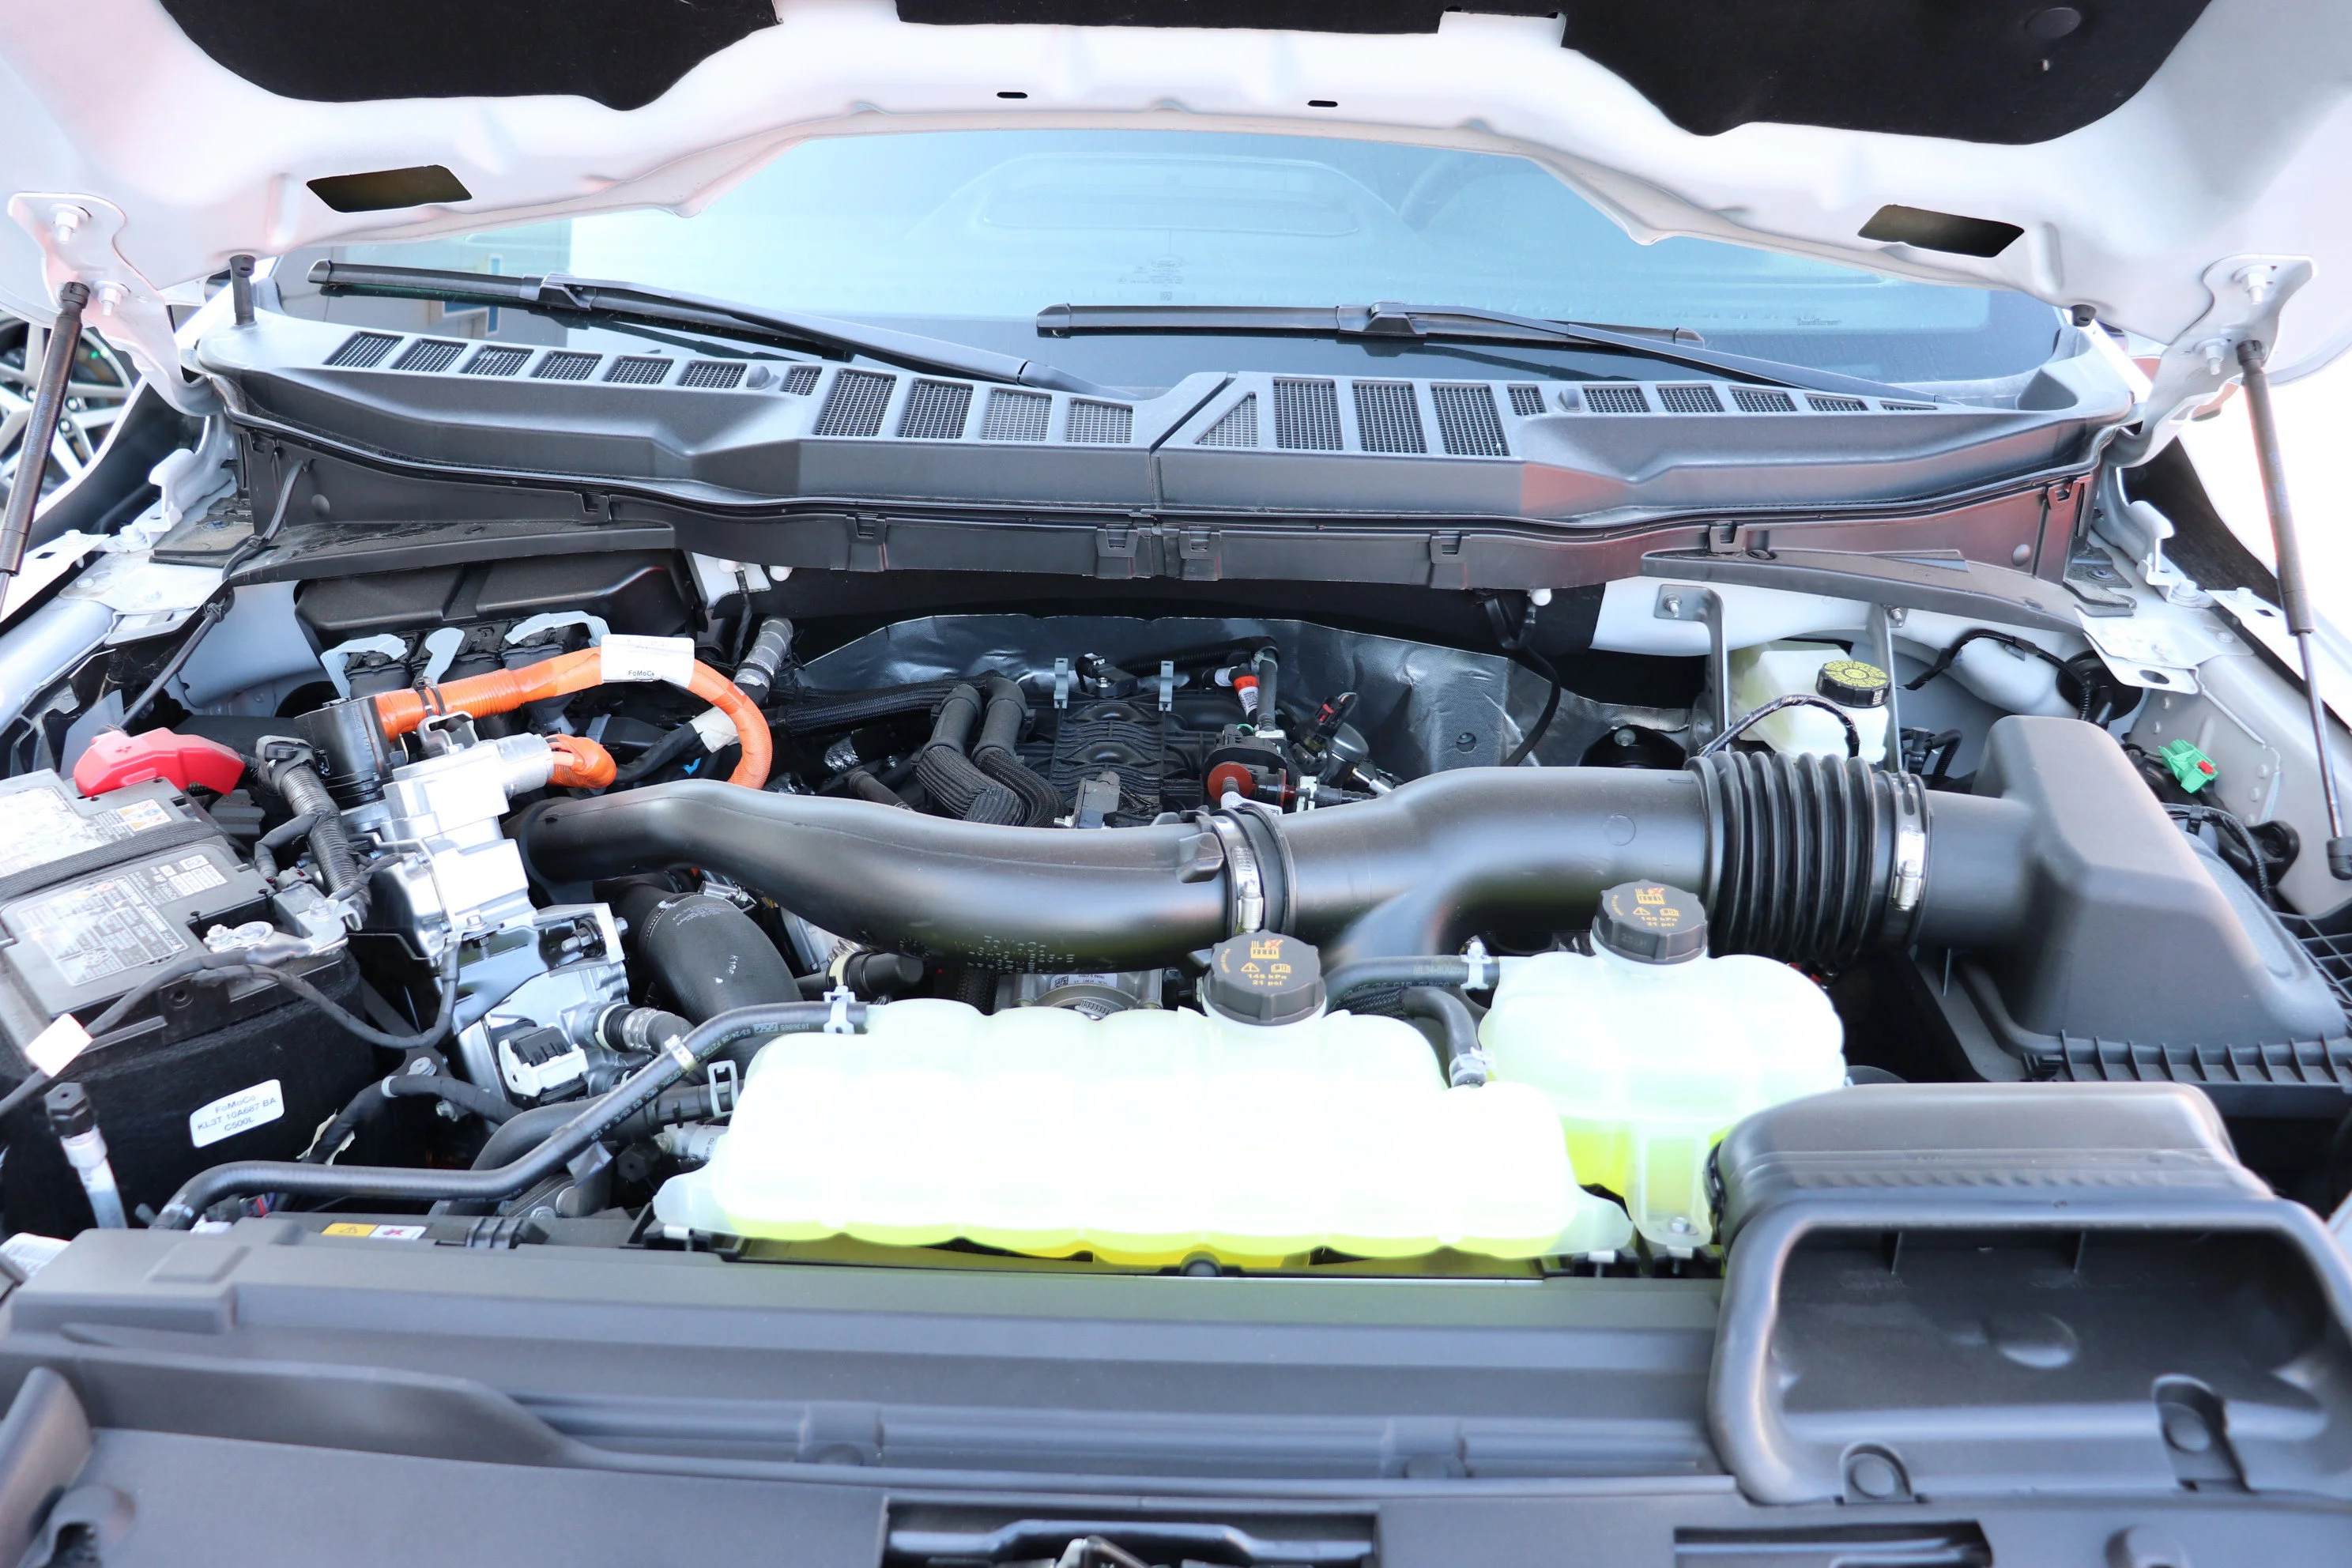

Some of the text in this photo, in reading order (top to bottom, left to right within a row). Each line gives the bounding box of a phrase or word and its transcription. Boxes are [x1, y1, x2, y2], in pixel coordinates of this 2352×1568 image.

[198, 1097, 276, 1130] KL3T 10A687 BA
[215, 1095, 256, 1114] FoMoCo
[224, 1117, 255, 1132] C500L
